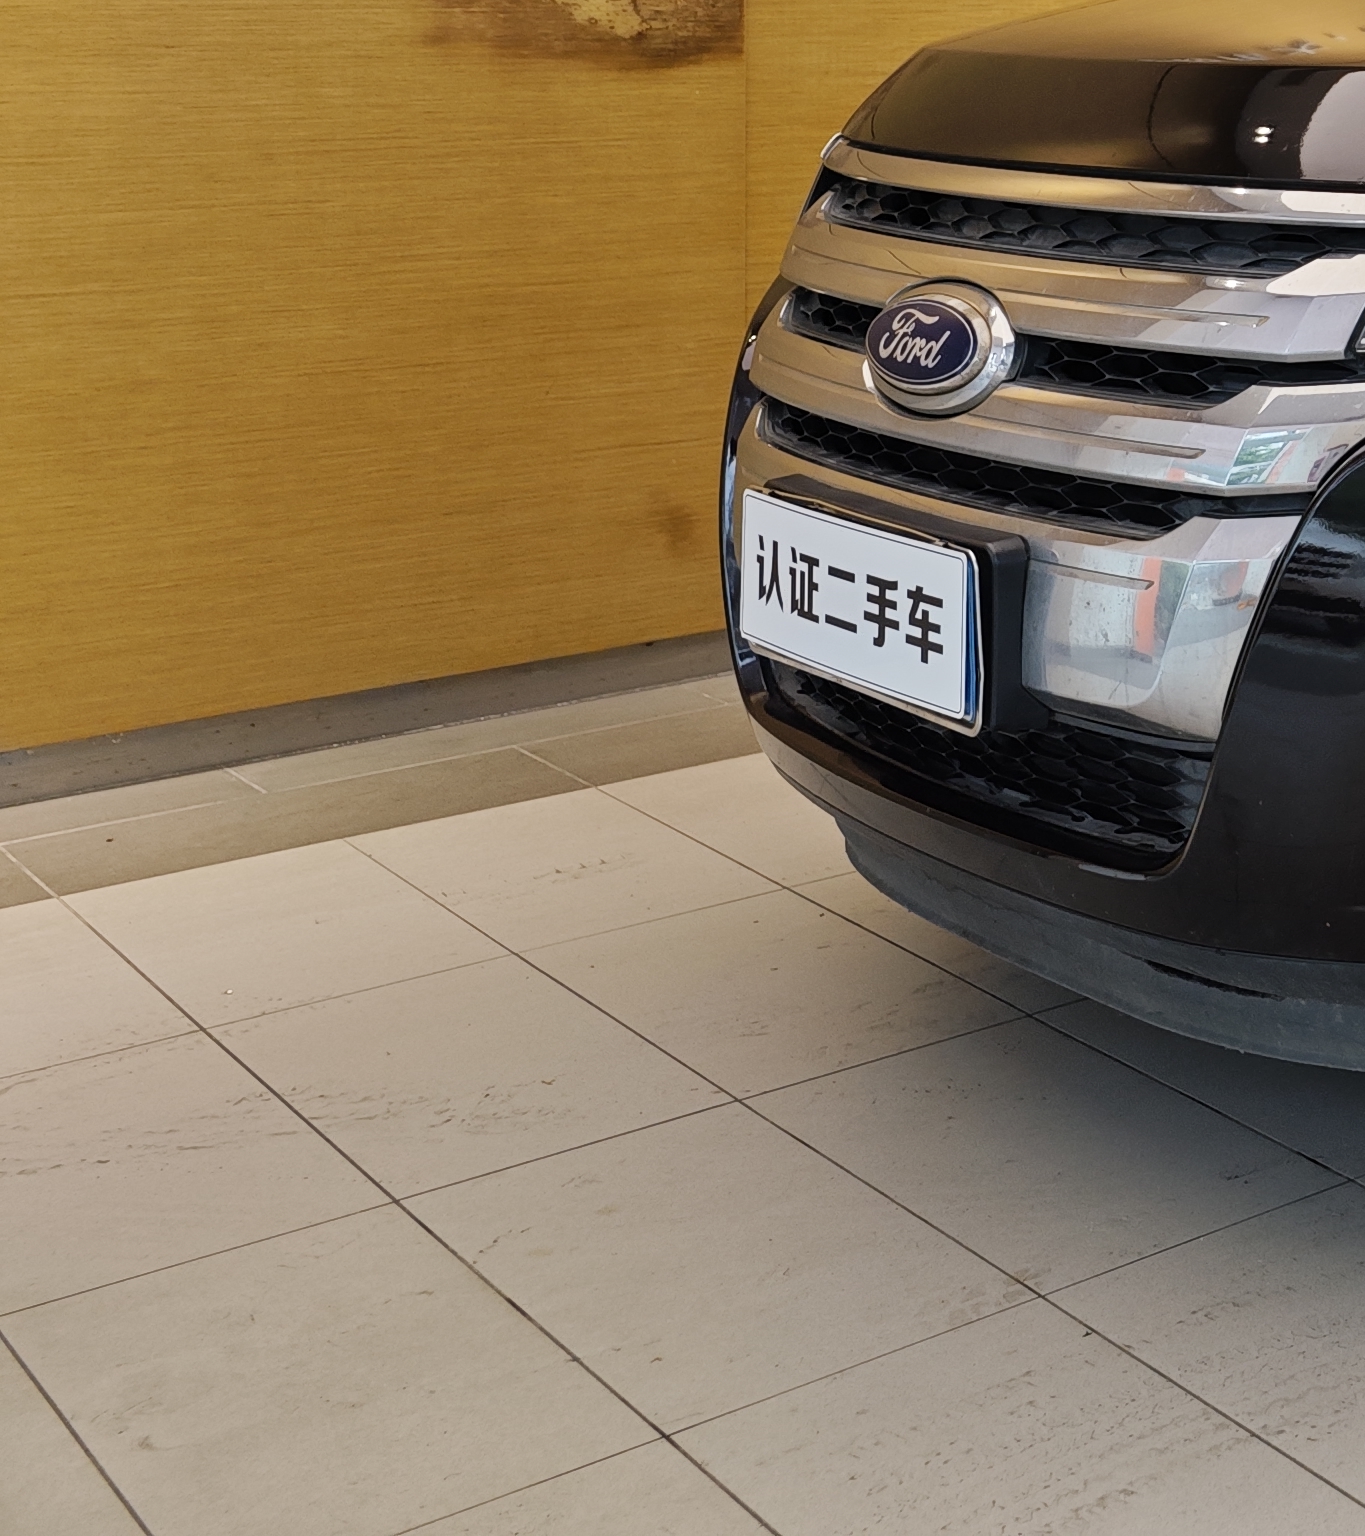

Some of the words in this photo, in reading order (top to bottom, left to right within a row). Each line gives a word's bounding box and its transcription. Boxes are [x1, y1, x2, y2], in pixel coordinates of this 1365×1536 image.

[879, 308, 951, 369] Ford
[756, 534, 944, 665] 认证二手车
